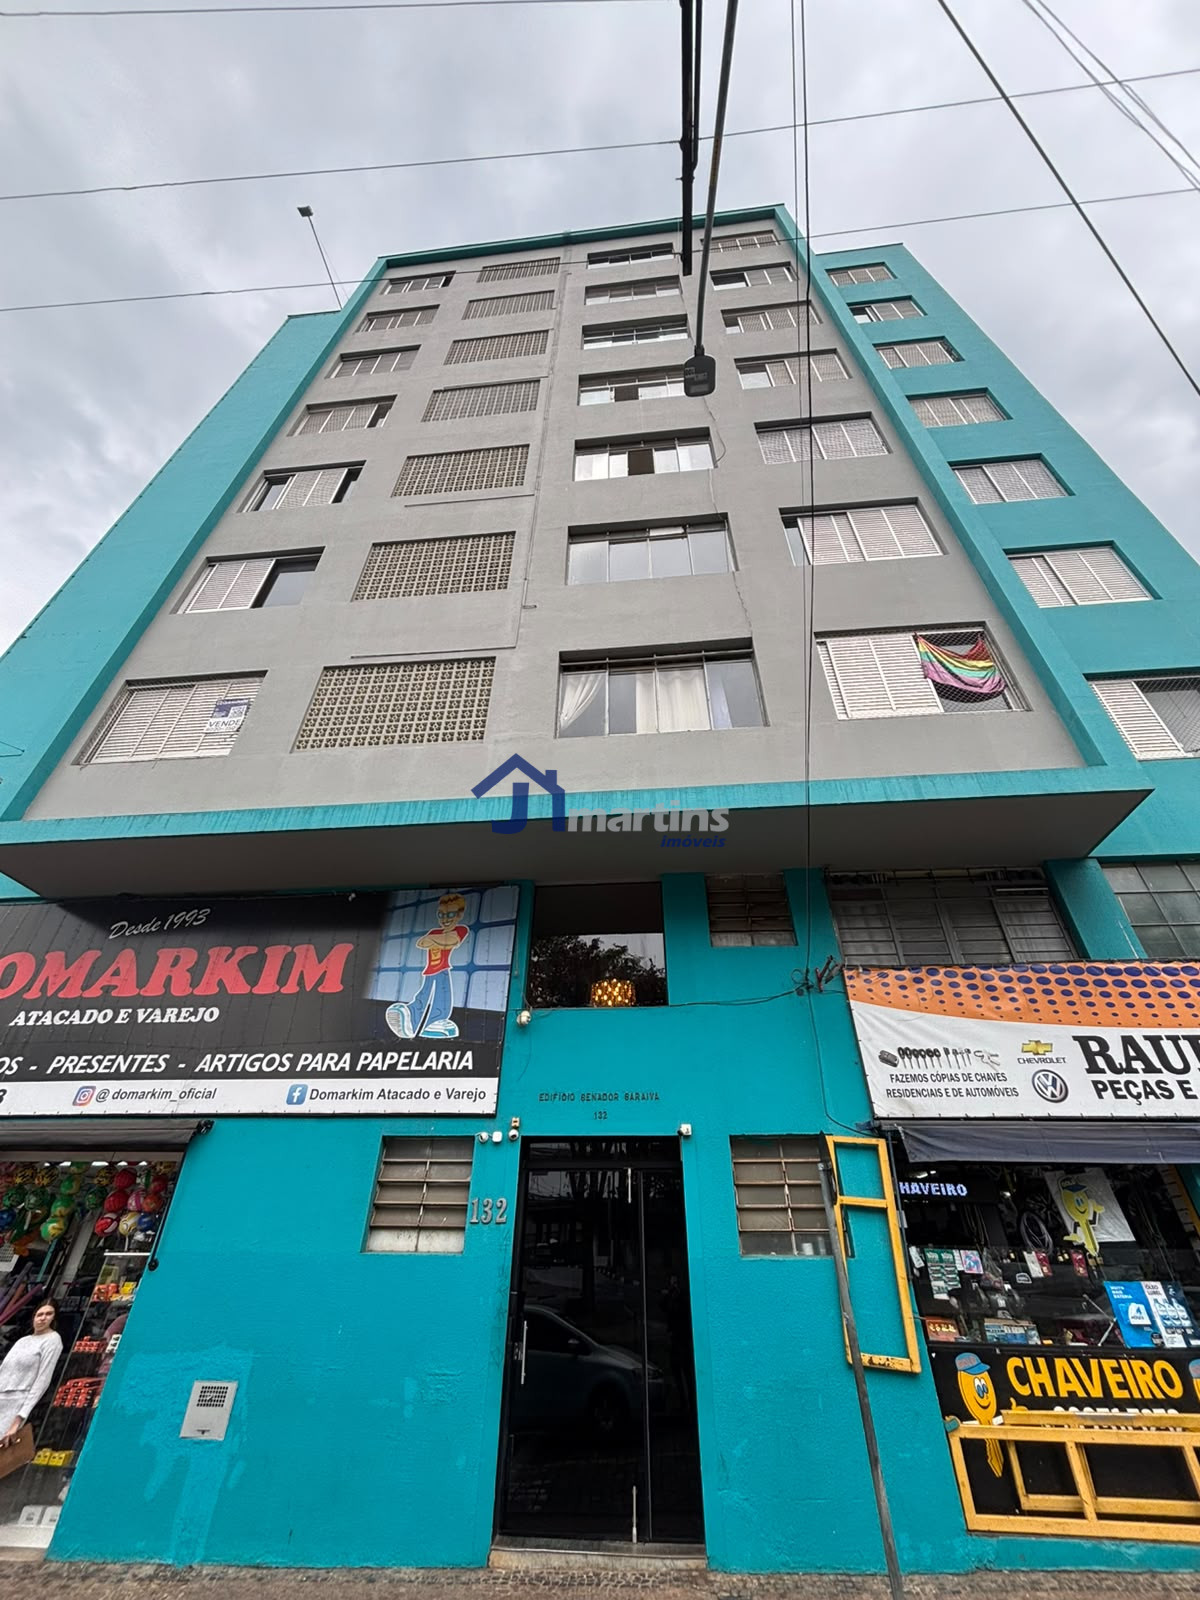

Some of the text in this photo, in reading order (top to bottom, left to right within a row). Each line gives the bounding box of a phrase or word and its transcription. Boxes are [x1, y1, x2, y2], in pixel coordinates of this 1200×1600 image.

[108, 908, 211, 939] Desde 1993
[9, 1007, 220, 1026] ATACADO E VAREJO
[46, 1054, 170, 1075] PRESENTES
[194, 1053, 293, 1073] ARTIGOS
[295, 1052, 351, 1072] PARA
[356, 1051, 473, 1071] PAPELARIA
[1017, 1057, 1067, 1065] CHEVROLET
[889, 1070, 1008, 1083] FAZEMOS CÓPIAS DE CHAVES
[309, 1088, 374, 1101] Domarkim
[377, 1088, 430, 1100] Atacado
[434, 1091, 442, 1100] e
[445, 1088, 487, 1102] Varejo
[886, 1085, 1020, 1098] RESIDENCIAIS E DE AUTOMÓVEIS
[1091, 1080, 1198, 1106] PEÇAS E
[593, 1111, 608, 1120] 132
[470, 1197, 508, 1225] 132
[1006, 1356, 1184, 1399] CHAVEIRO
